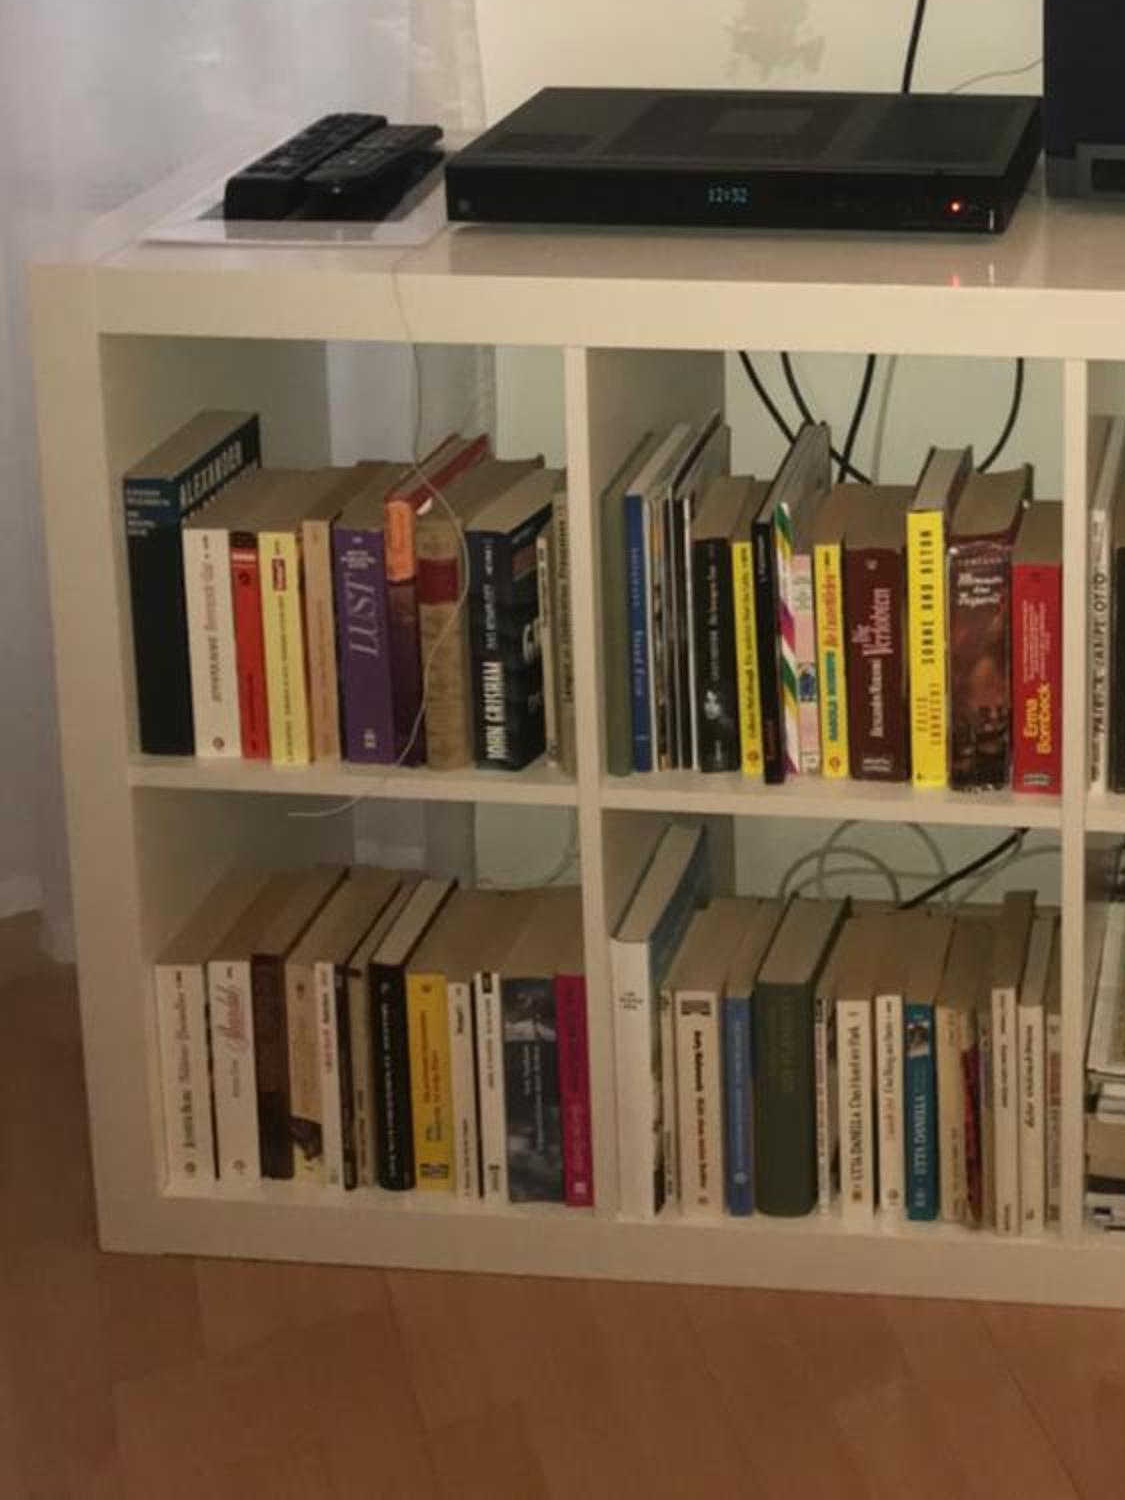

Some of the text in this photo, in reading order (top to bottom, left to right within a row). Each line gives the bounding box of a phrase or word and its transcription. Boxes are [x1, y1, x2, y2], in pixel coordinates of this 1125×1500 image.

[343, 574, 379, 656] LUST
[482, 661, 505, 722] GRISHAM
[1023, 698, 1040, 737] Erma
[1036, 683, 1052, 754] Bombeck
[484, 726, 508, 759] JOHN
